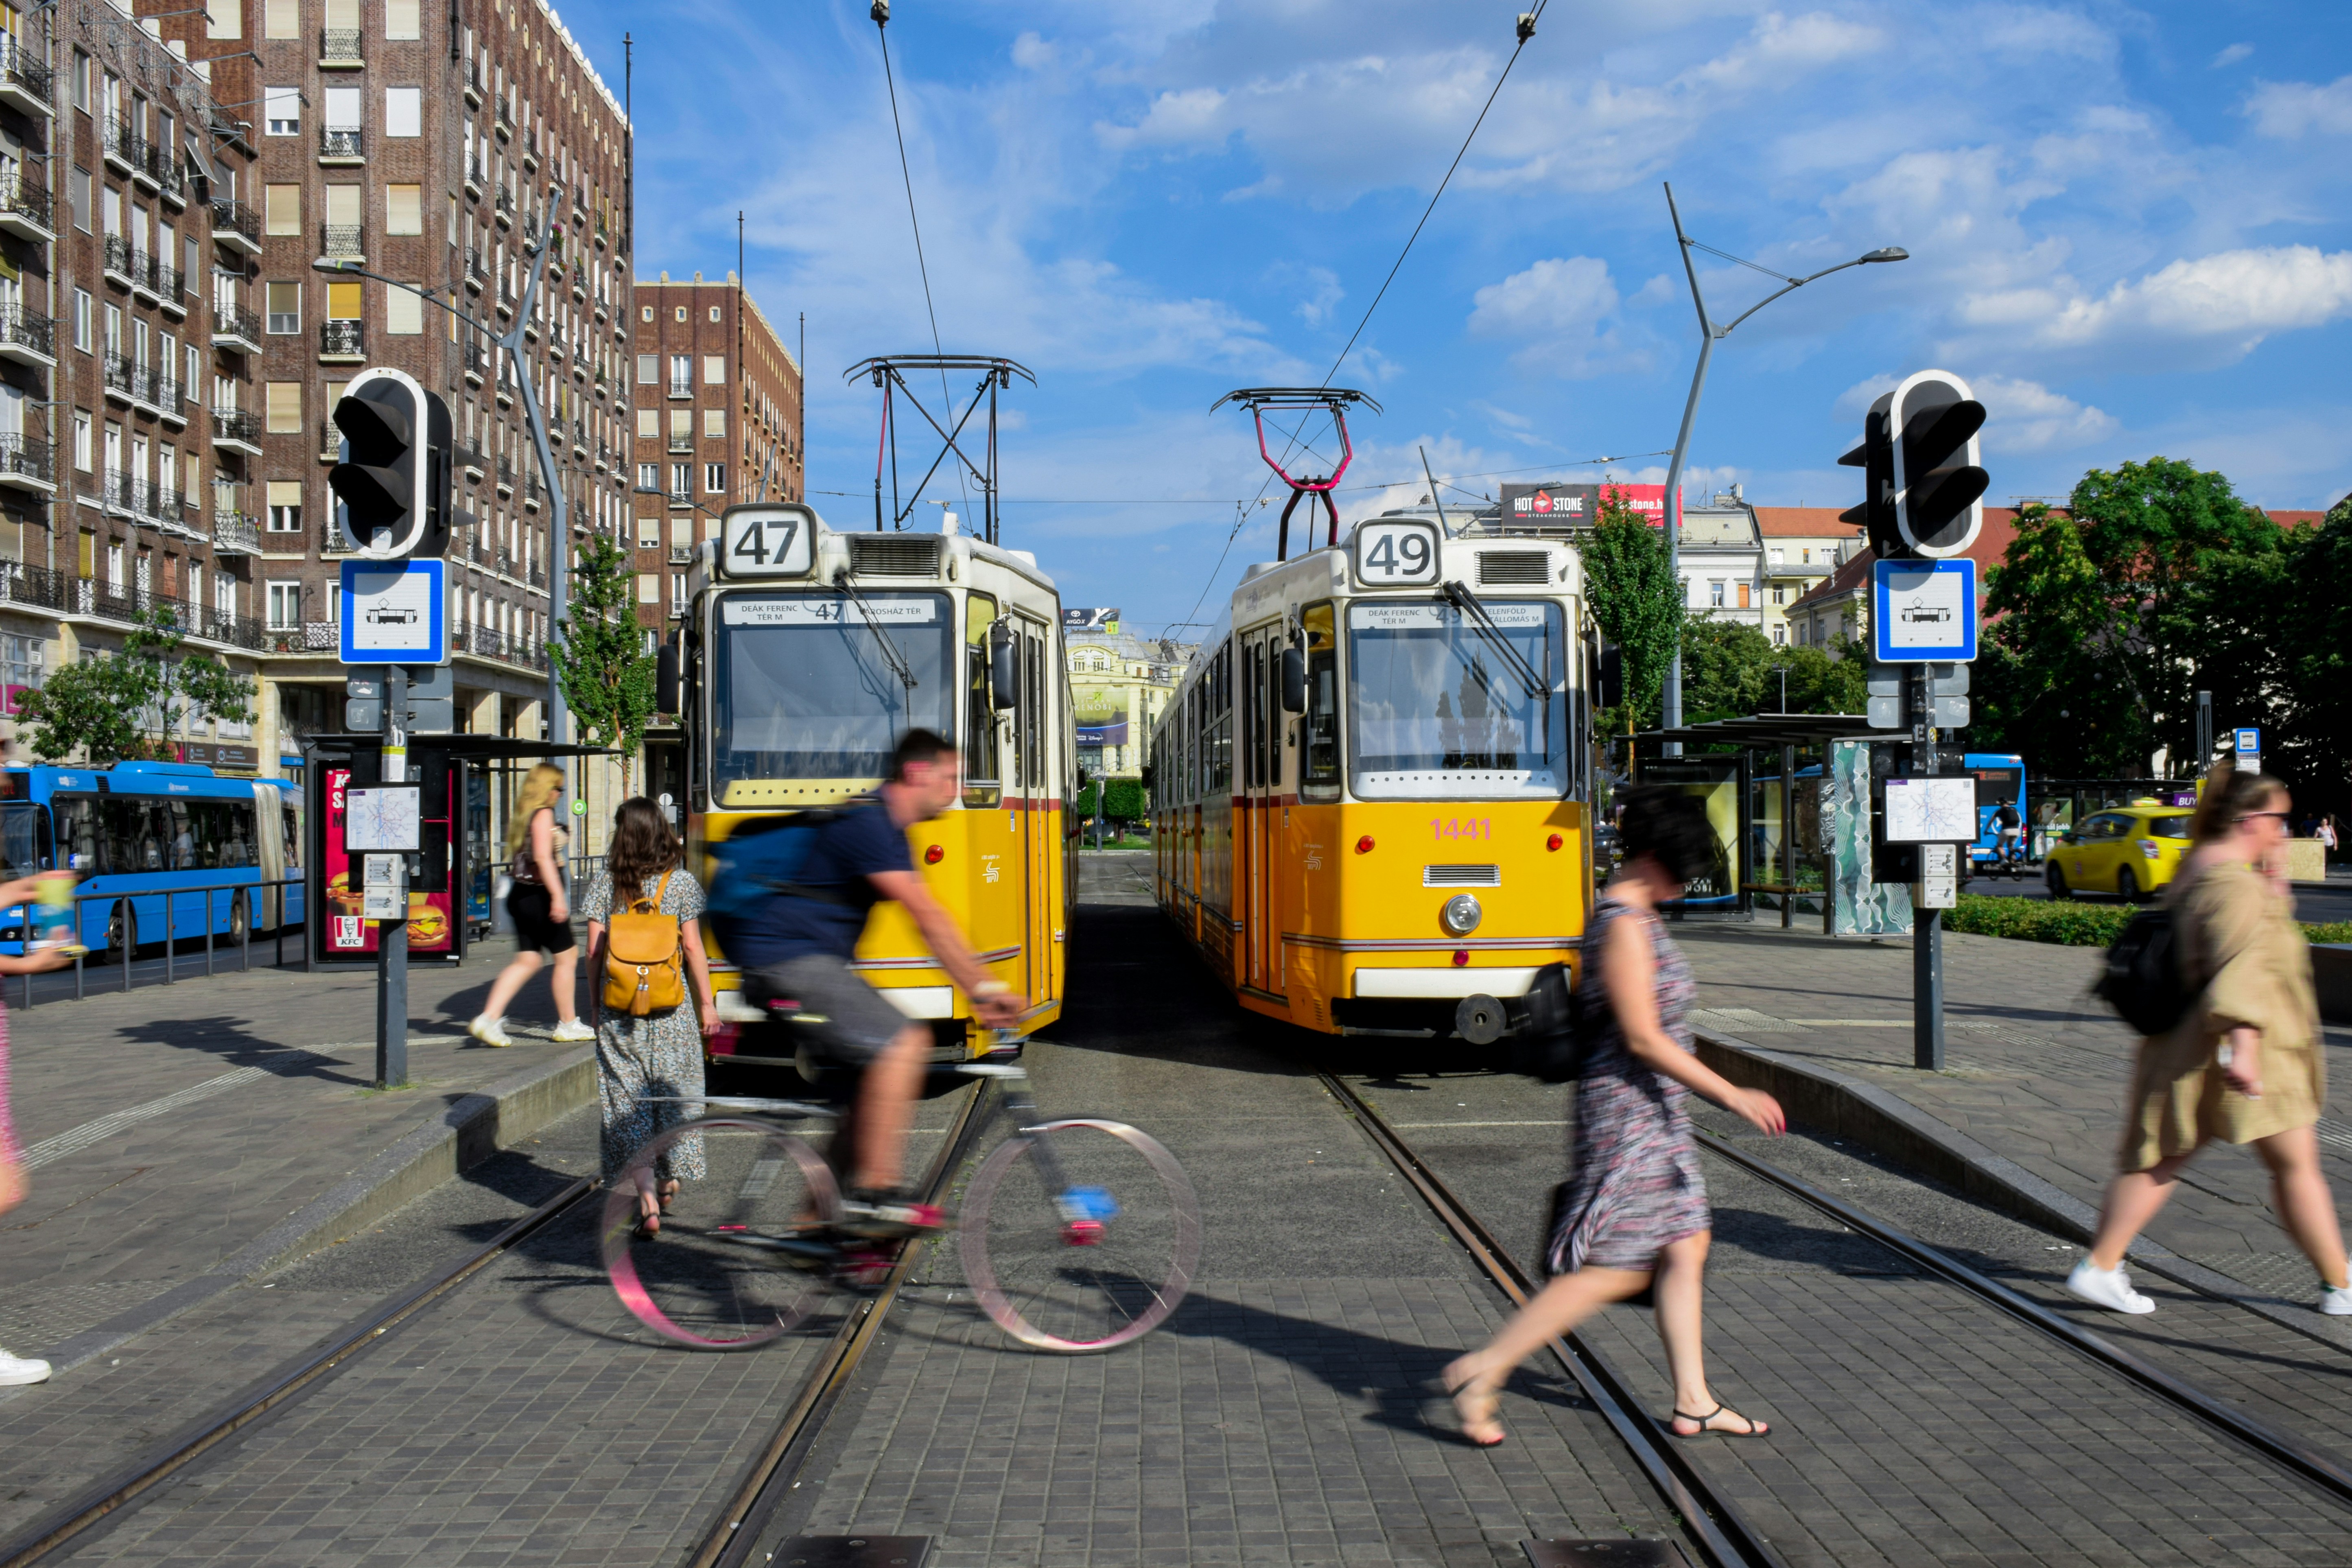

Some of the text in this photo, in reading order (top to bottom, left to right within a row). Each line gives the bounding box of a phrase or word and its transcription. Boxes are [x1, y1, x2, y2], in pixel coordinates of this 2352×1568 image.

[1515, 497, 1583, 511] HOT STONE
[734, 521, 798, 565] 47
[1366, 534, 1430, 575] 49
[815, 604, 843, 621] 47
[1436, 608, 1462, 624] 49
[1430, 818, 1490, 840] 1441
